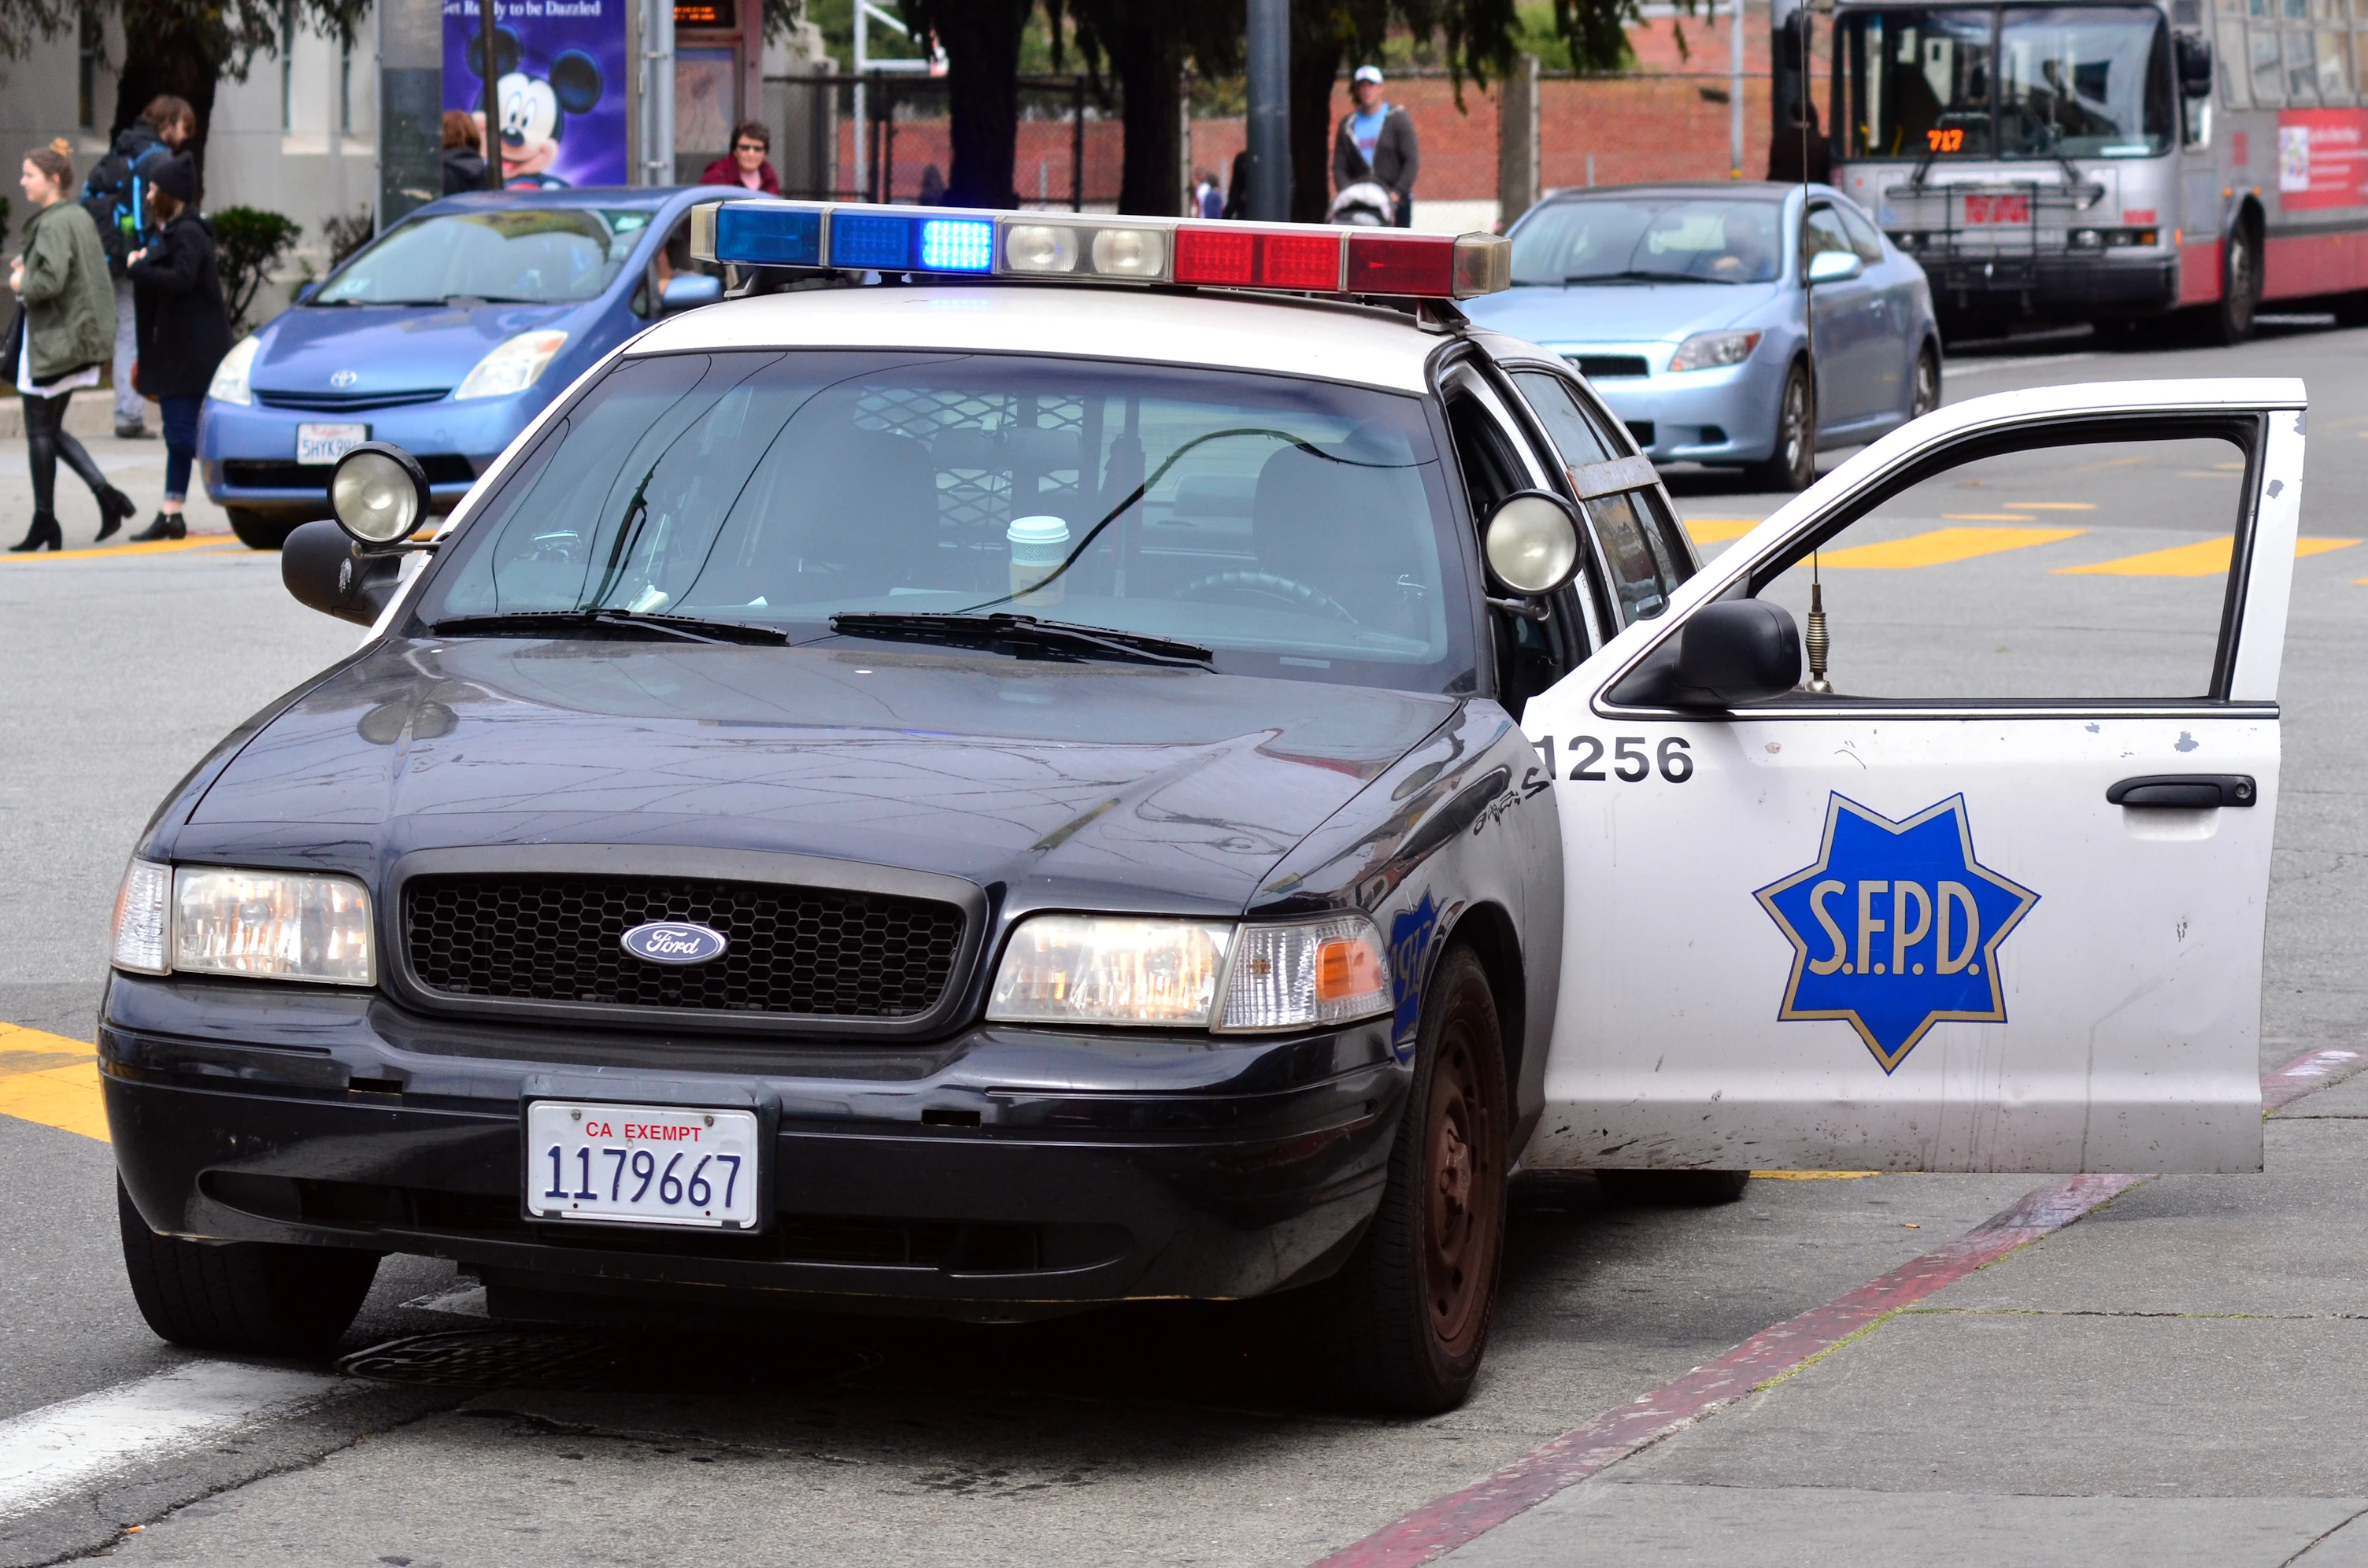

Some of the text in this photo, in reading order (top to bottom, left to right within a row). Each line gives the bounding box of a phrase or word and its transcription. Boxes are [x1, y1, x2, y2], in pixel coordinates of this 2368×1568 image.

[510, 3, 524, 16] to
[526, 1, 543, 16] be
[546, 1, 601, 16] Dazzled
[1927, 129, 1963, 152] 717
[1532, 735, 1694, 784] 1256
[1808, 879, 1980, 976] S.F.P.D.
[646, 930, 701, 954] Ford
[586, 1122, 702, 1142] CA EXEMPT
[545, 1145, 741, 1208] 1179667
